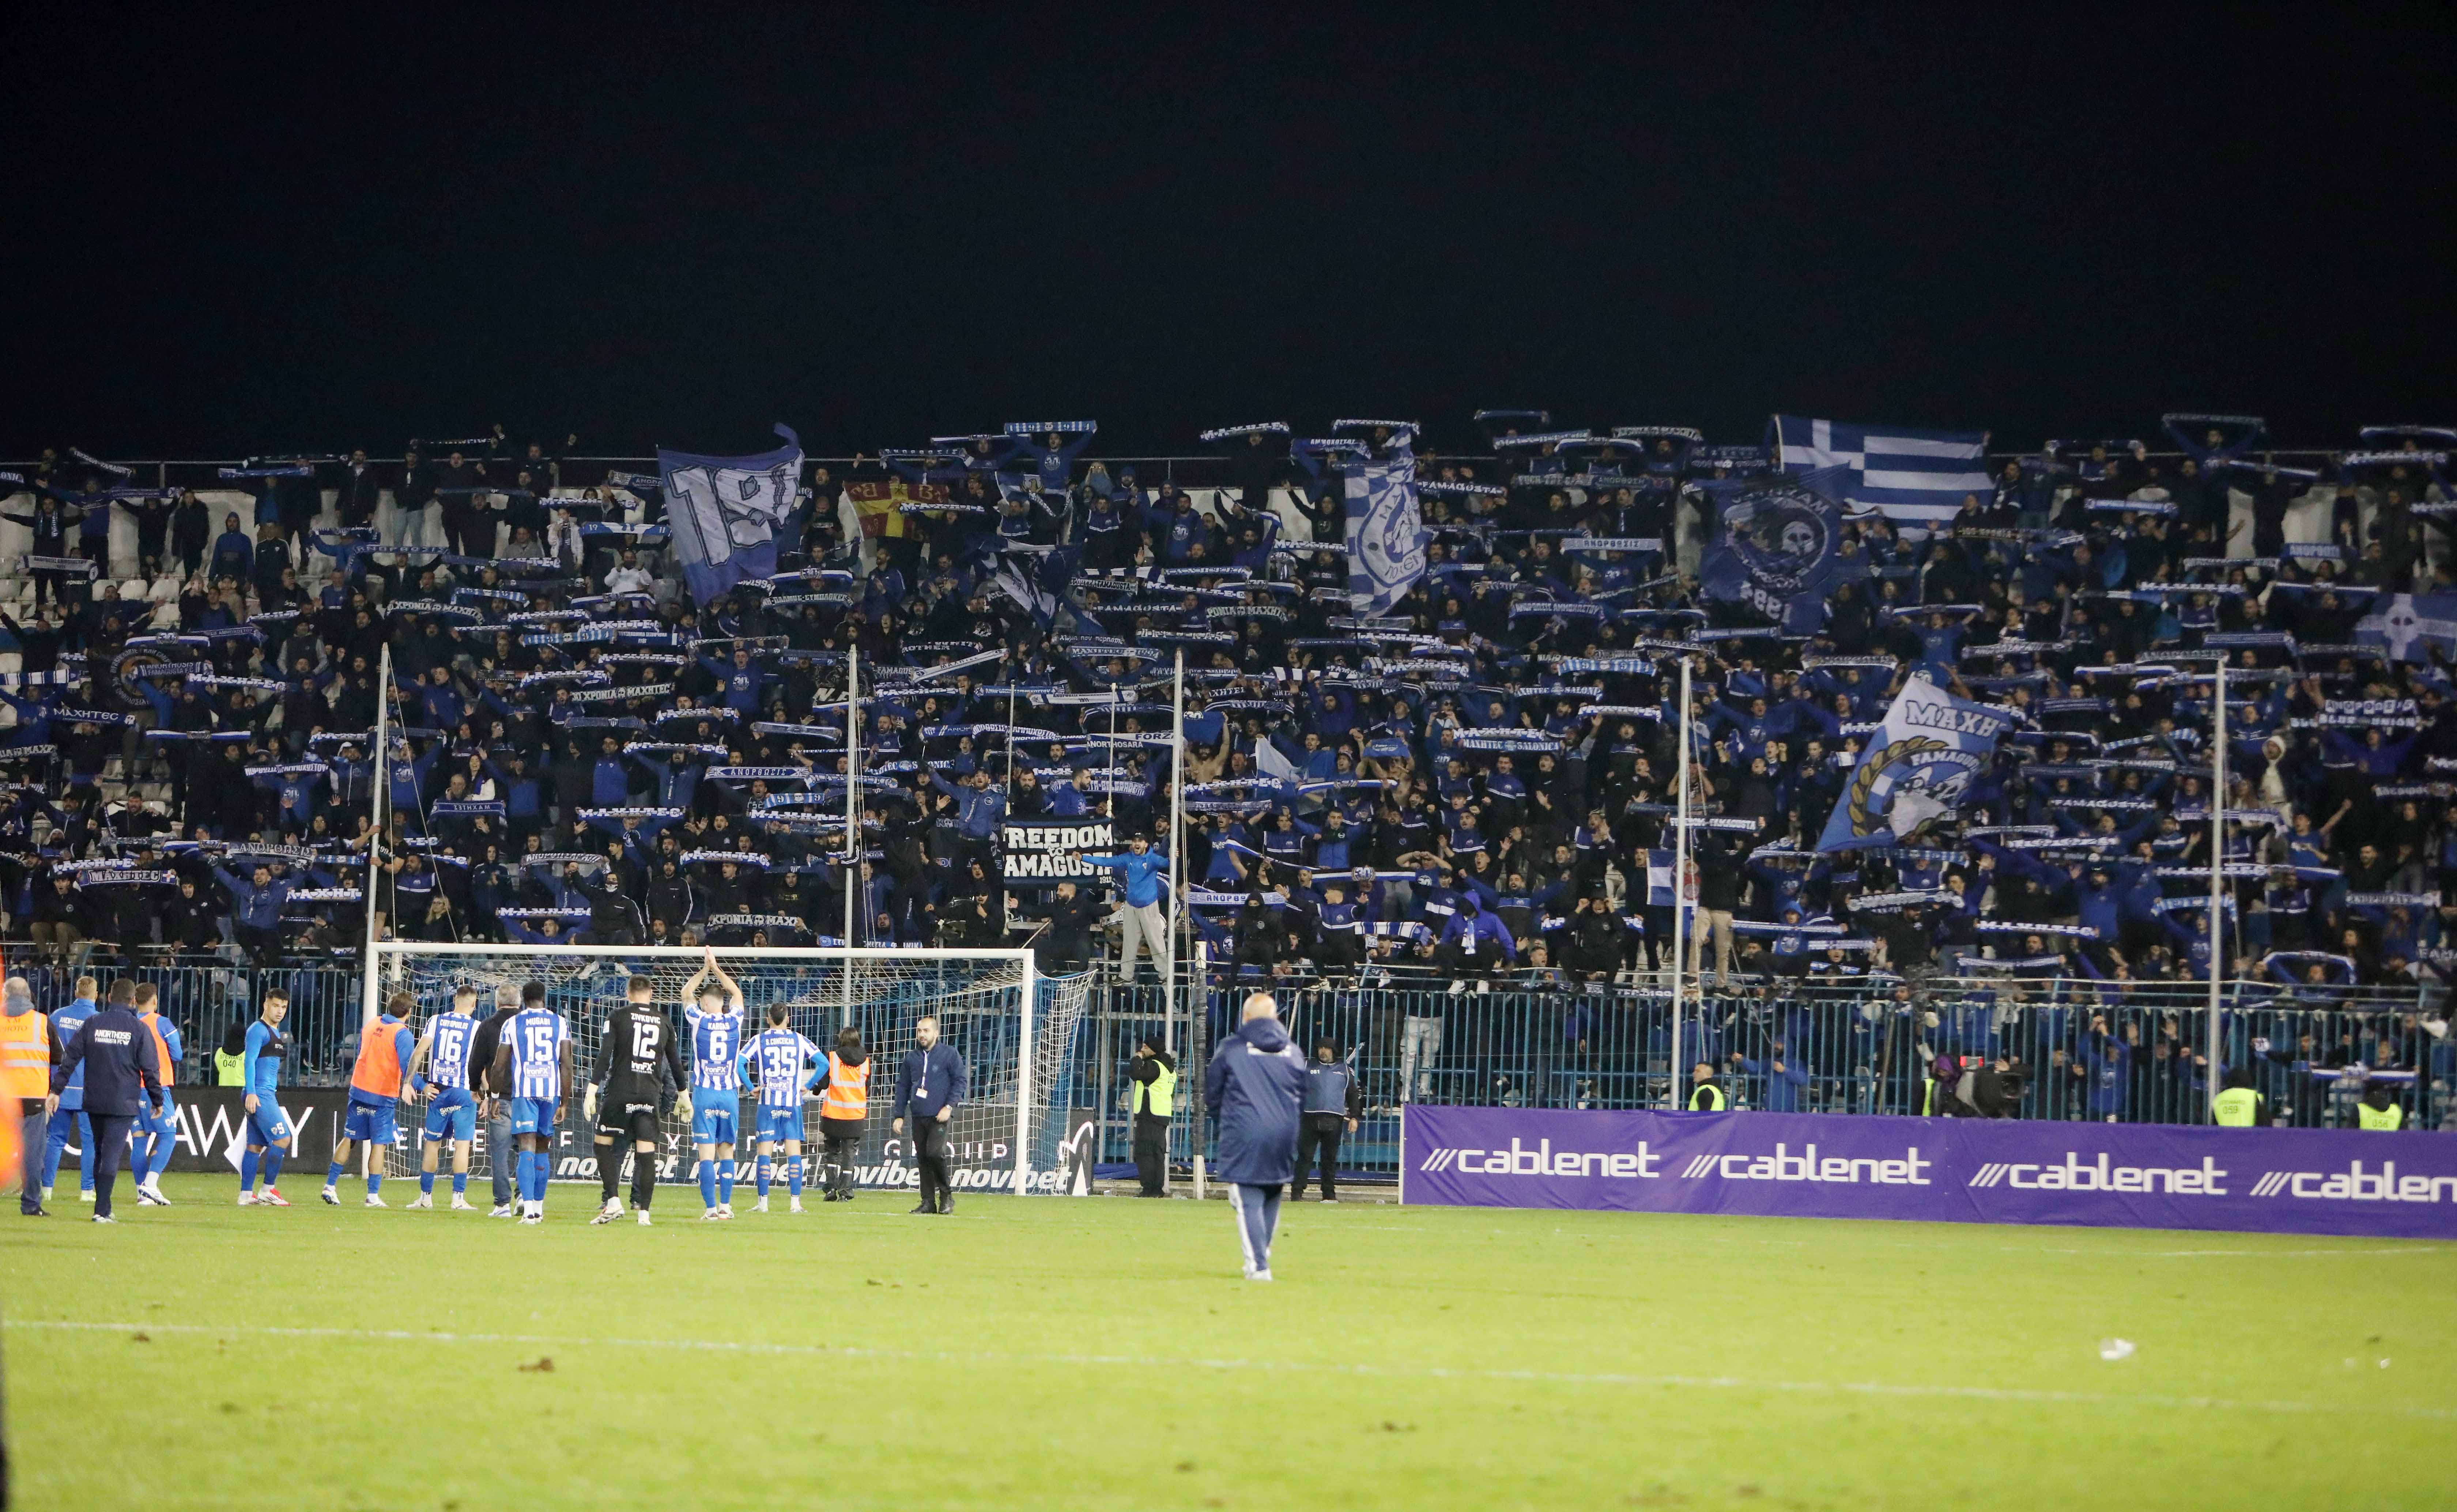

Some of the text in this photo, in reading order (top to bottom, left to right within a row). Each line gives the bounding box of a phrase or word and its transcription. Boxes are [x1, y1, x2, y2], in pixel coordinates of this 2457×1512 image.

[238, 843, 311, 858] ΑΝΟΡΘΩΣΙΣ
[1047, 845, 1065, 857] to
[526, 1017, 550, 1026] MUGABI
[630, 1012, 661, 1025] ZIVKOVIC
[707, 1022, 730, 1031] KARGAS
[95, 1029, 132, 1040] ANORTHOSIS
[633, 1021, 660, 1059] 12
[438, 1028, 464, 1062] 16
[524, 1027, 553, 1062] 15
[709, 1030, 728, 1061] 6
[223, 1059, 236, 1067] 040
[764, 1046, 797, 1077] 35
[705, 1066, 726, 1074] IronFX
[625, 1103, 655, 1112] Singular
[704, 1109, 731, 1117] Singular
[1458, 1137, 1660, 1178] cablenet
[1720, 1142, 1930, 1185] cablenet
[2009, 1152, 2228, 1196] cablenet
